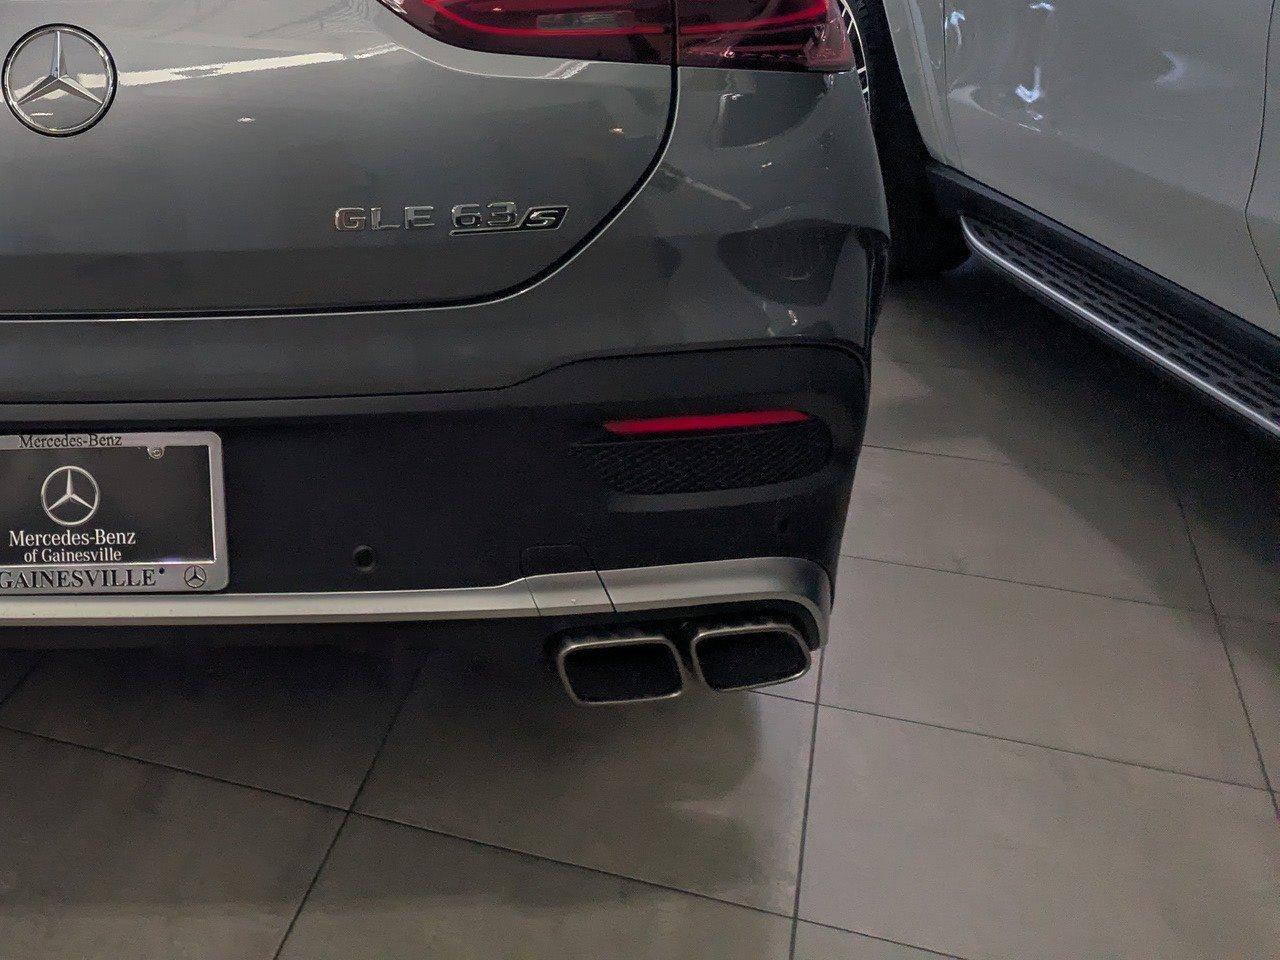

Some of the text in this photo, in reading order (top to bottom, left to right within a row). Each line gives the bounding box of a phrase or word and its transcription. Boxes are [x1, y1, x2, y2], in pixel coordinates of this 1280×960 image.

[334, 205, 436, 231] GLE
[19, 433, 123, 449] Mercedes-Benz
[8, 529, 137, 548] Mercedes-Benz
[23, 547, 122, 563] of Gainesville
